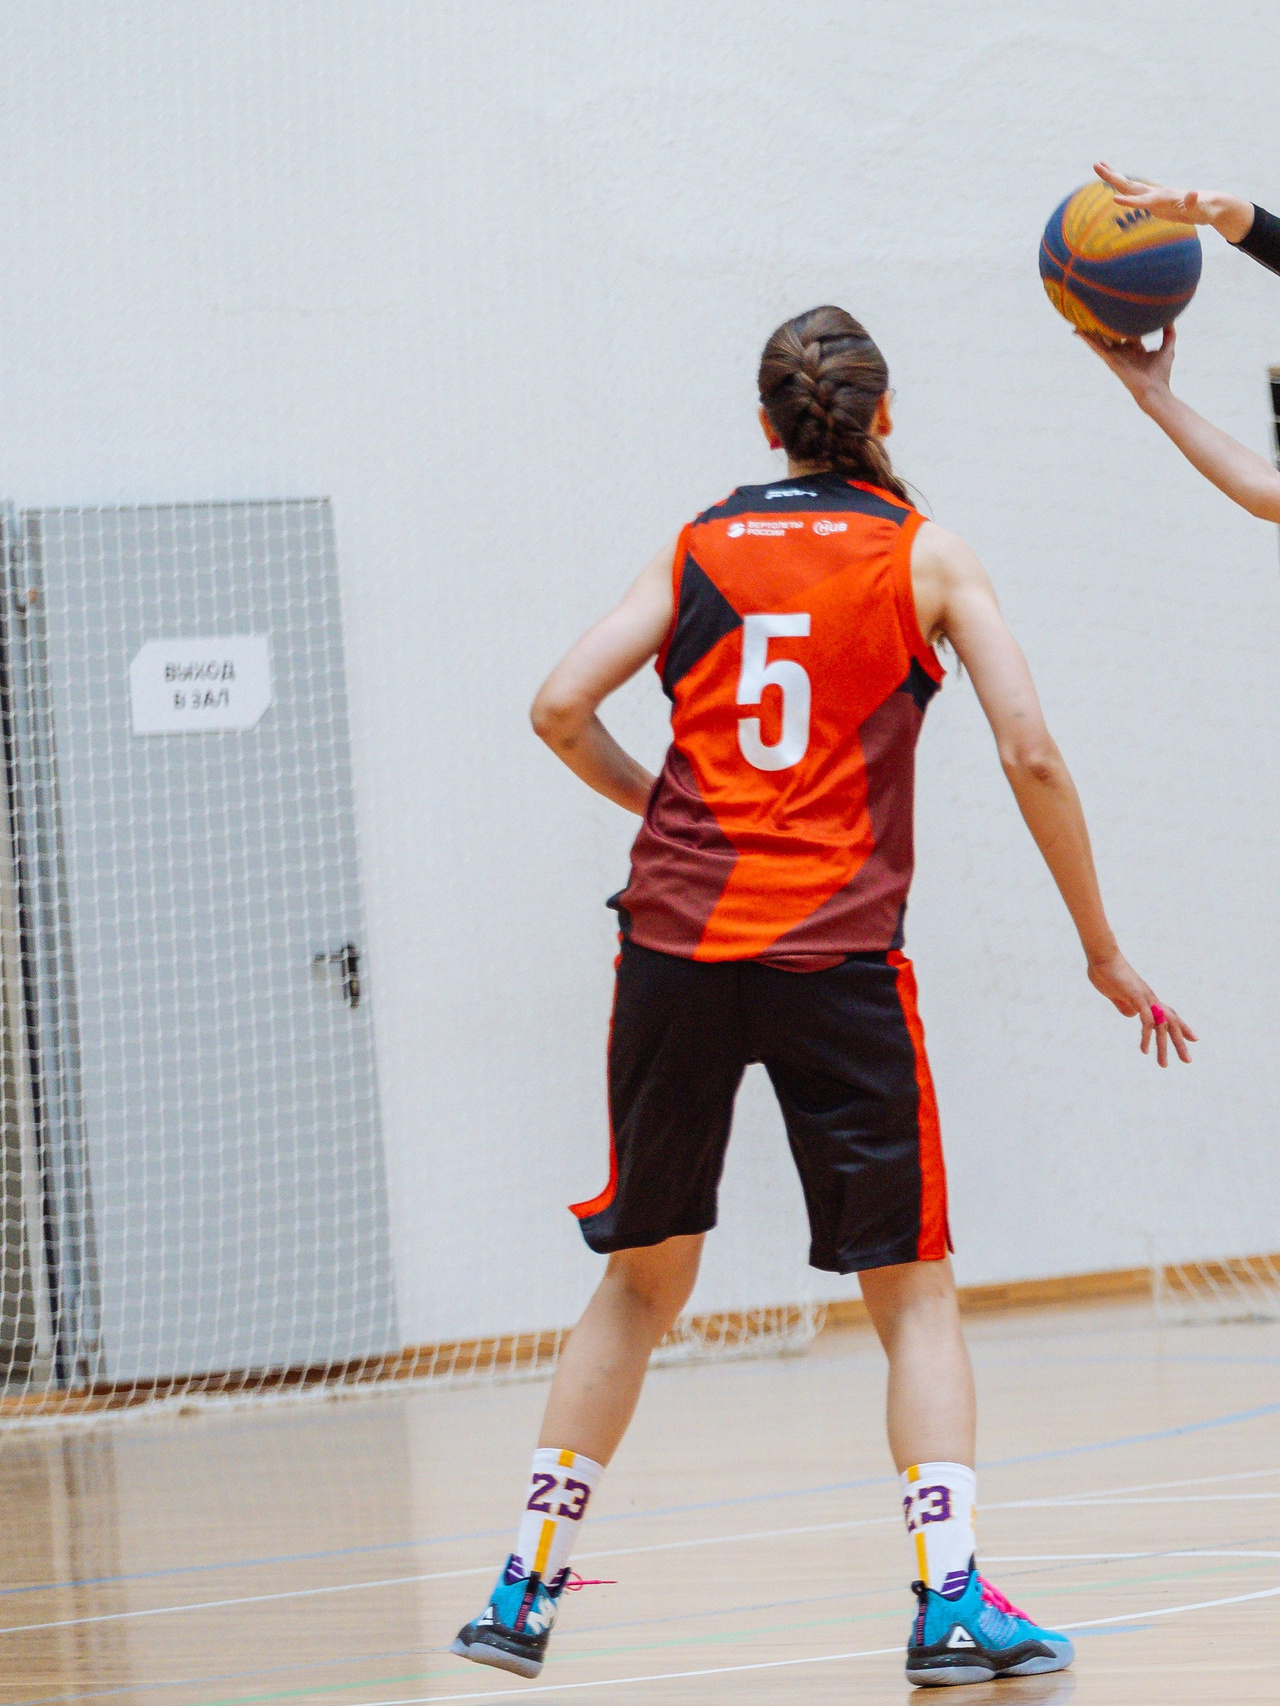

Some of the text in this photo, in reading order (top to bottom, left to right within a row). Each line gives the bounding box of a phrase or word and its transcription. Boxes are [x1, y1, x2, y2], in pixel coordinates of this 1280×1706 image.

[165, 660, 236, 682] ВЫХОД
[174, 689, 230, 709] В ЗАЛ
[736, 612, 812, 772] 5
[526, 1472, 592, 1521] 23
